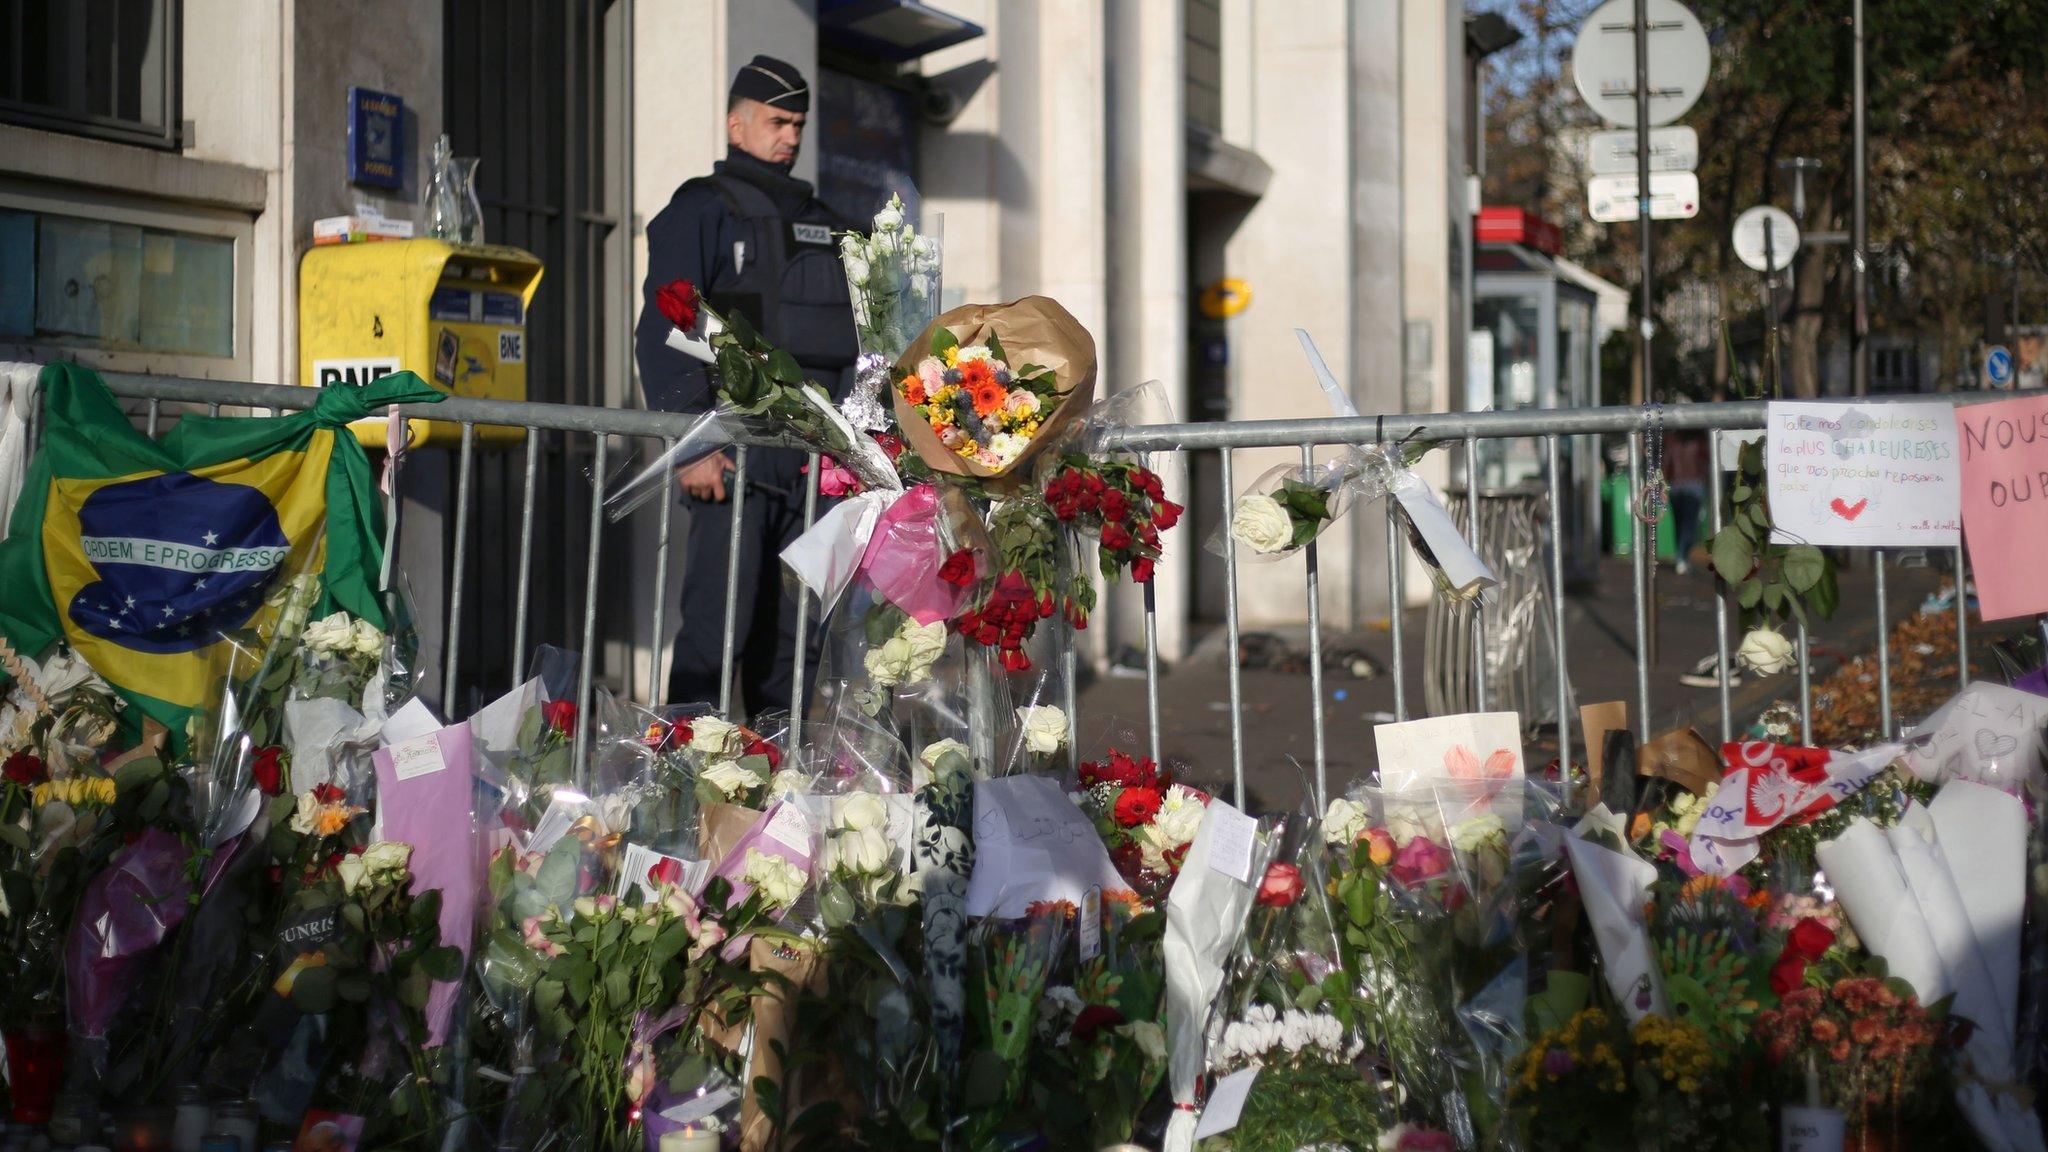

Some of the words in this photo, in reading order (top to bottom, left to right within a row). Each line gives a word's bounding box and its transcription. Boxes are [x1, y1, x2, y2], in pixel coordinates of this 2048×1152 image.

[797, 227, 827, 240] POLICE
[500, 334, 521, 360] BNE
[83, 540, 134, 560] ORDEM
[144, 544, 156, 562] E
[161, 546, 286, 570] PROGRESSO
